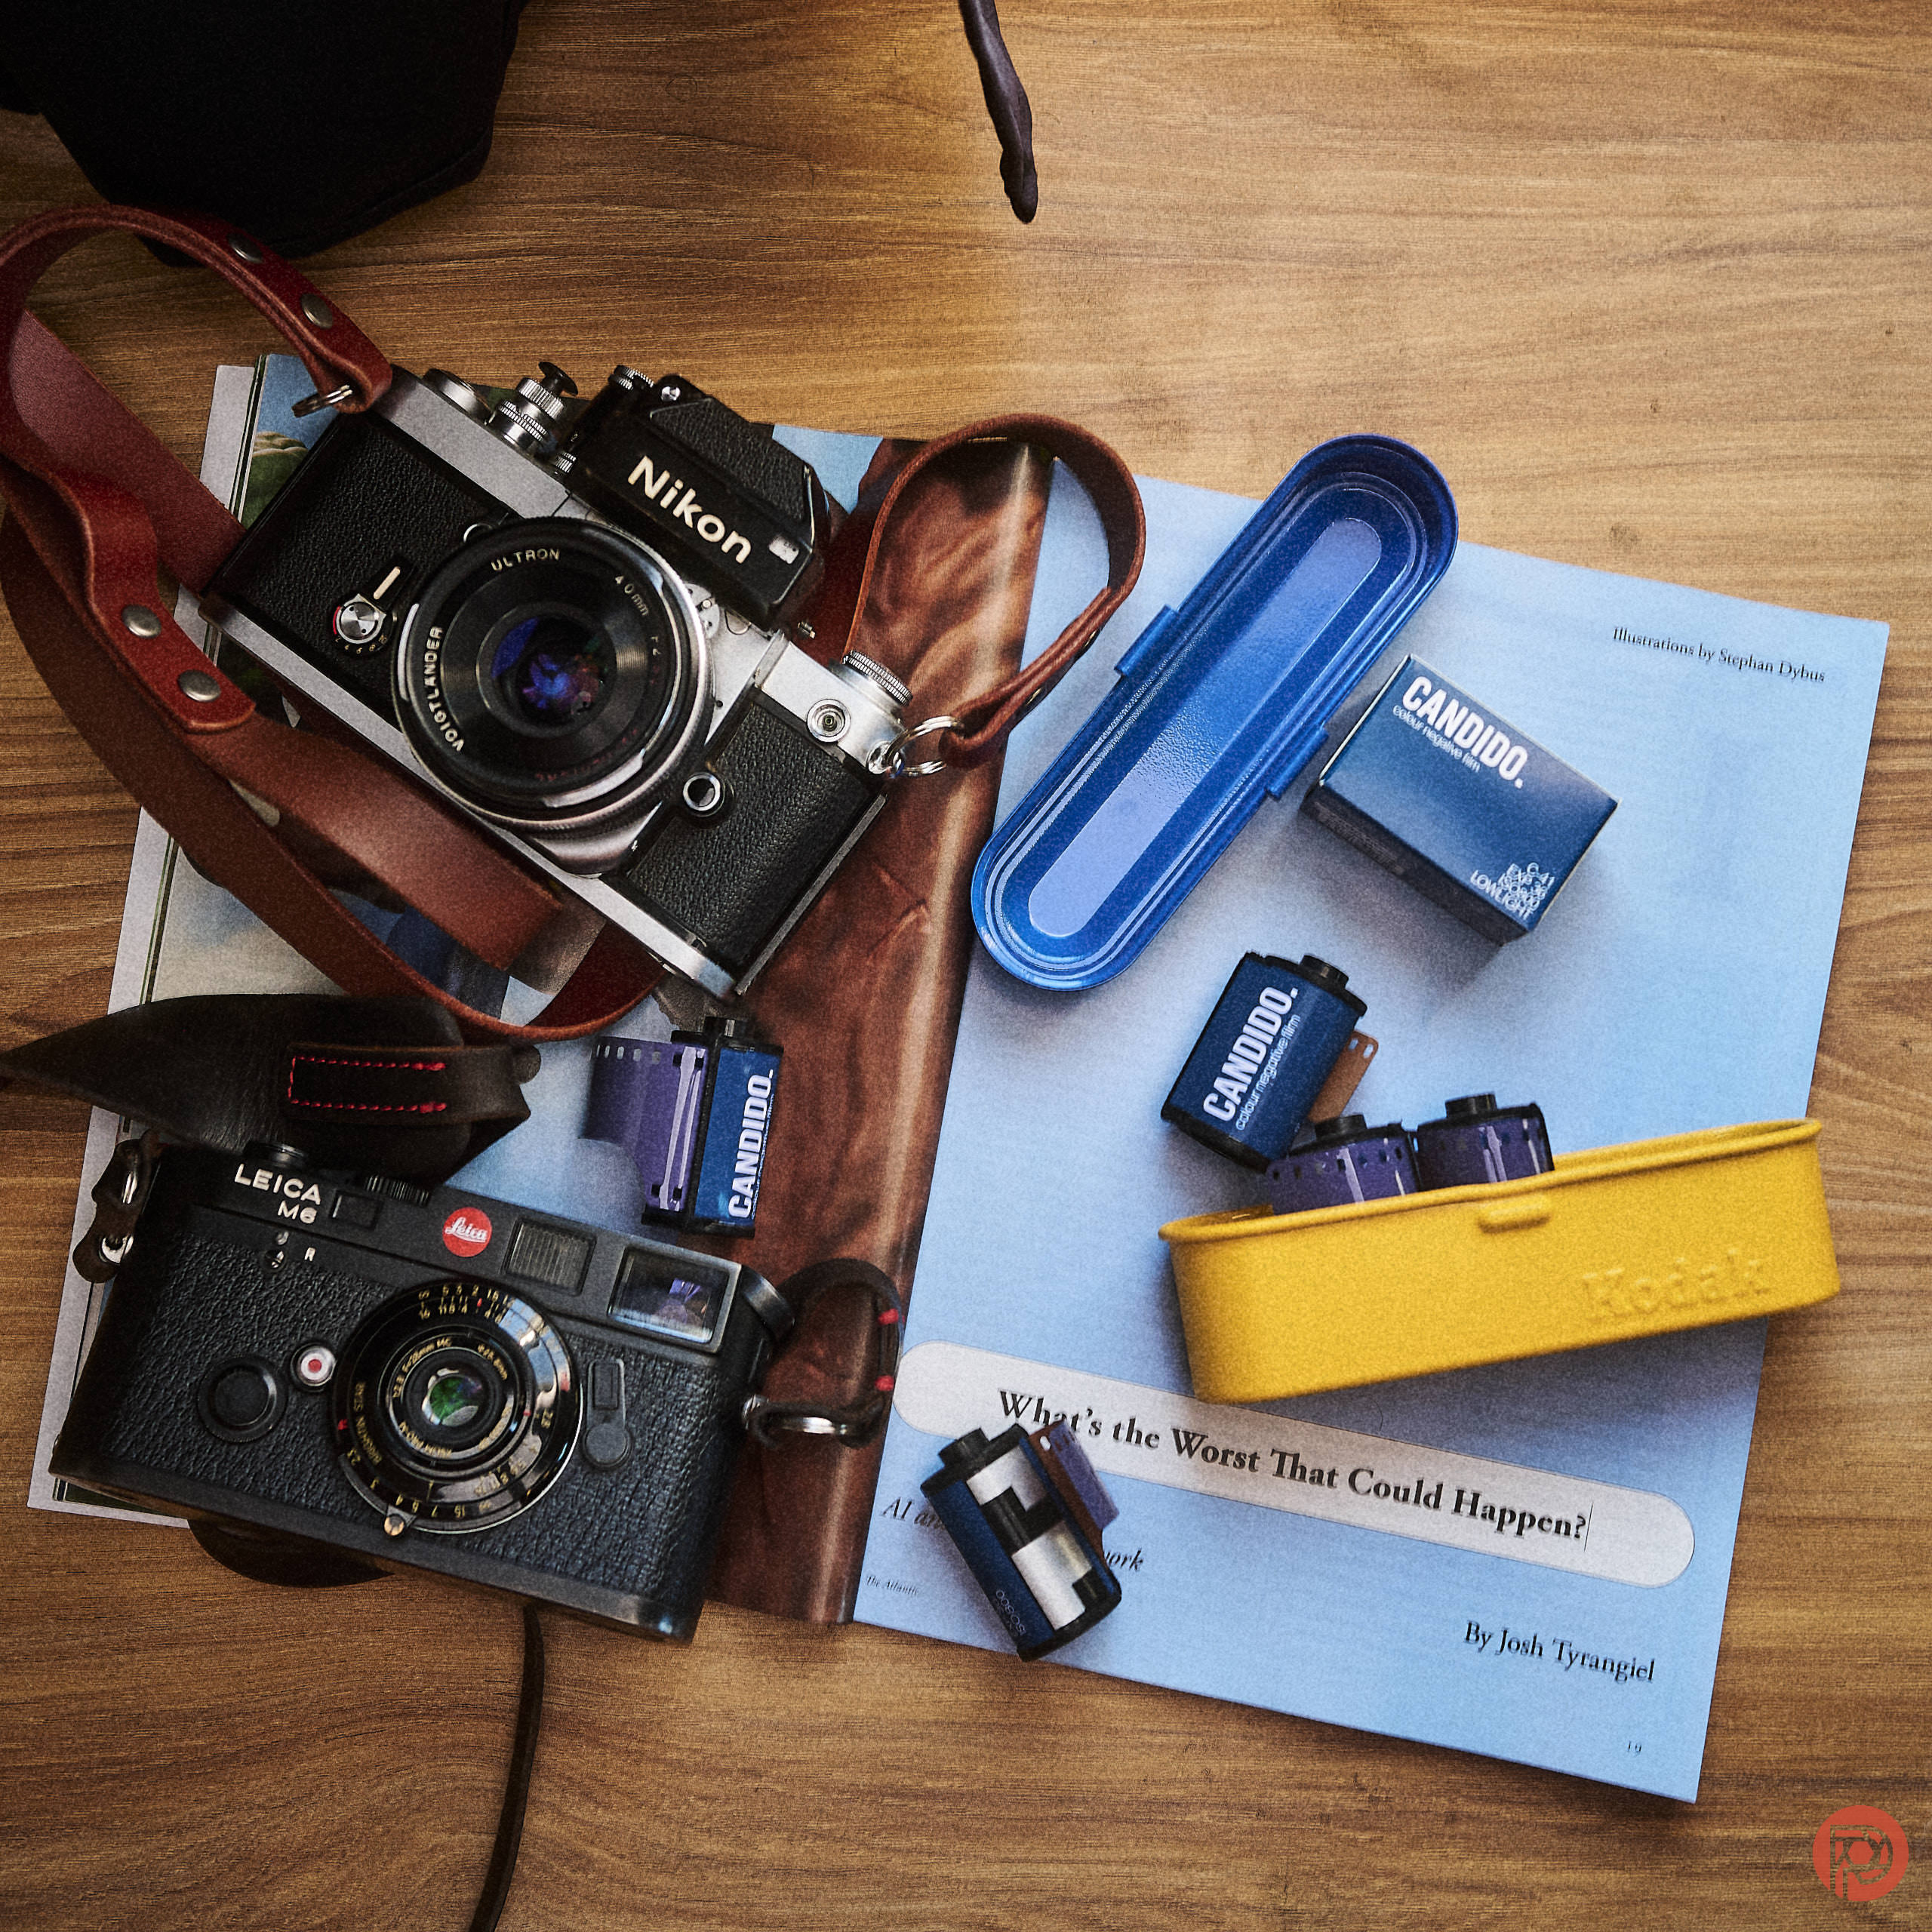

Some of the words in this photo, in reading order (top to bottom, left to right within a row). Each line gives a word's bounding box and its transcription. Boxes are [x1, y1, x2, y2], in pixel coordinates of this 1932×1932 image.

[627, 455, 752, 564] Nikon
[491, 549, 561, 571] ULTRON
[1612, 626, 1694, 656] Illustrations
[1697, 642, 1715, 663] by
[1718, 647, 1774, 674] Stephan
[1779, 660, 1826, 684] Dybus
[1392, 705, 1423, 732] colour
[1421, 725, 1463, 758] negative
[1462, 752, 1482, 773] film
[1401, 675, 1528, 789] CANDIDO.
[1469, 869, 1534, 921] LOWLIGHT
[1202, 986, 1300, 1122] CANDIDO.
[1235, 1089, 1263, 1131] colour
[1256, 1038, 1288, 1092] negative
[1281, 1014, 1301, 1041] film
[728, 1069, 774, 1219] CANDIDO.
[234, 1163, 321, 1205] LEICA
[277, 1200, 318, 1224] M6
[445, 1217, 488, 1243] Leica
[1582, 1248, 1770, 1321] Kodak
[879, 1497, 915, 1521] AI
[1112, 1415, 1161, 1450] the
[1171, 1428, 1260, 1472] Worst
[1270, 1447, 1339, 1489] That
[1348, 1467, 1444, 1512] Could
[1451, 1487, 1587, 1540] Happen?
[1464, 1620, 1494, 1654] By
[1494, 1626, 1544, 1660] Josh
[1552, 1636, 1656, 1684] Tyrangiel
